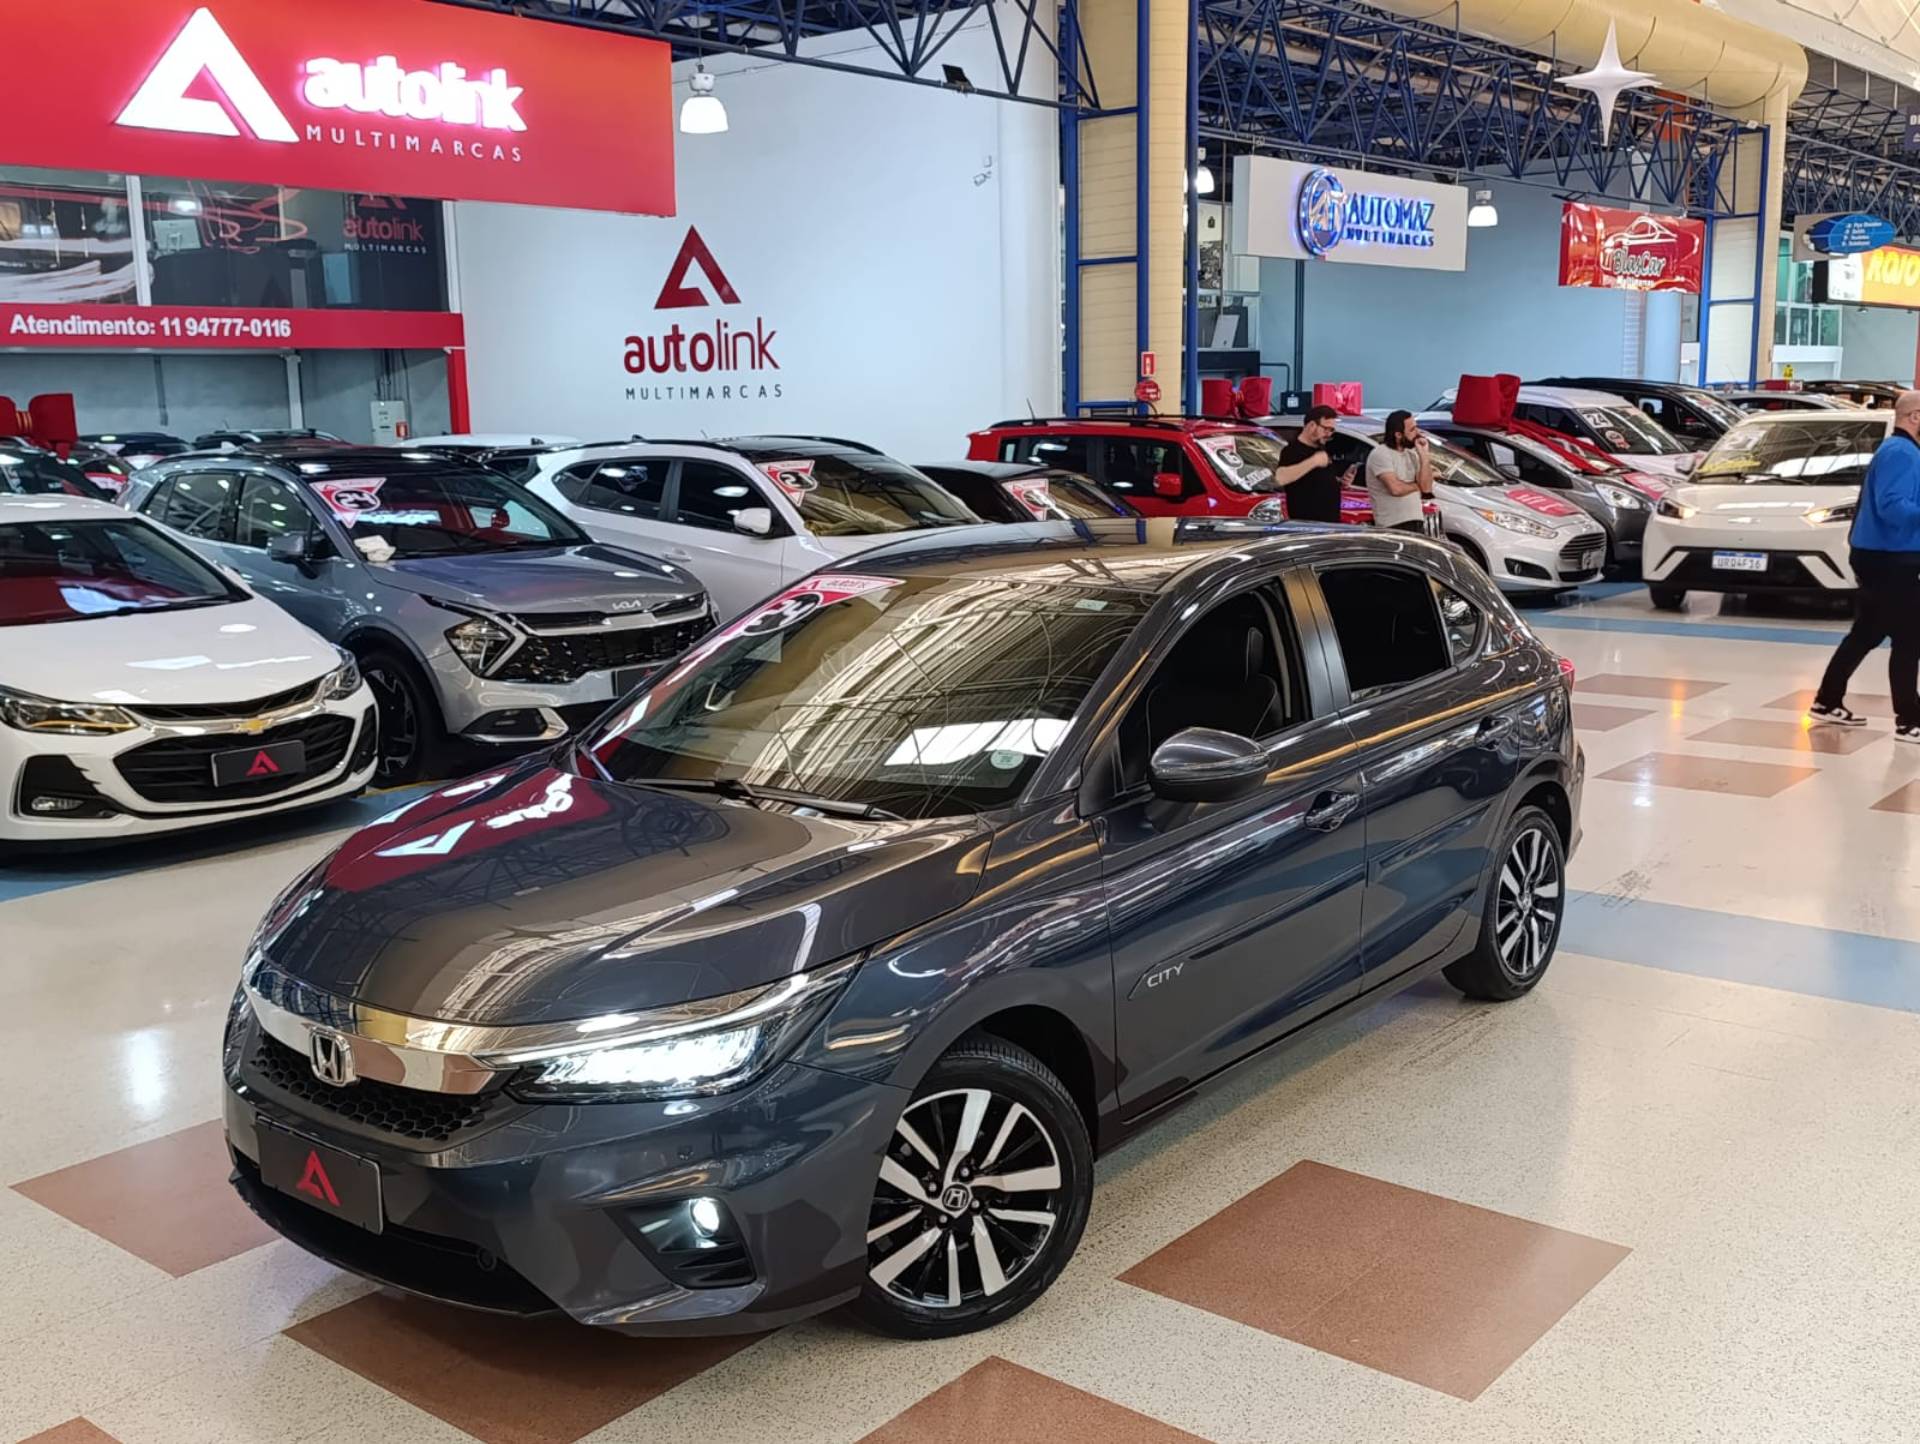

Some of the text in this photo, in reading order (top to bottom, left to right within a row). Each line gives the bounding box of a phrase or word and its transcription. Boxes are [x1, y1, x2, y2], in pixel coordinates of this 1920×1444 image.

[304, 55, 528, 132] autolink
[306, 124, 522, 163] MULTIMARCAS
[1347, 192, 1435, 232] AUTOMAZ
[343, 217, 424, 241] autolink
[1346, 227, 1434, 247] MULTIMARCAS
[344, 243, 427, 254] MULTIMARCAS
[10, 314, 292, 338] Atendimento: 11 94777-0116
[624, 317, 780, 374] autolink
[625, 384, 783, 400] MULTIMARCAS
[1147, 962, 1184, 987] CITY
